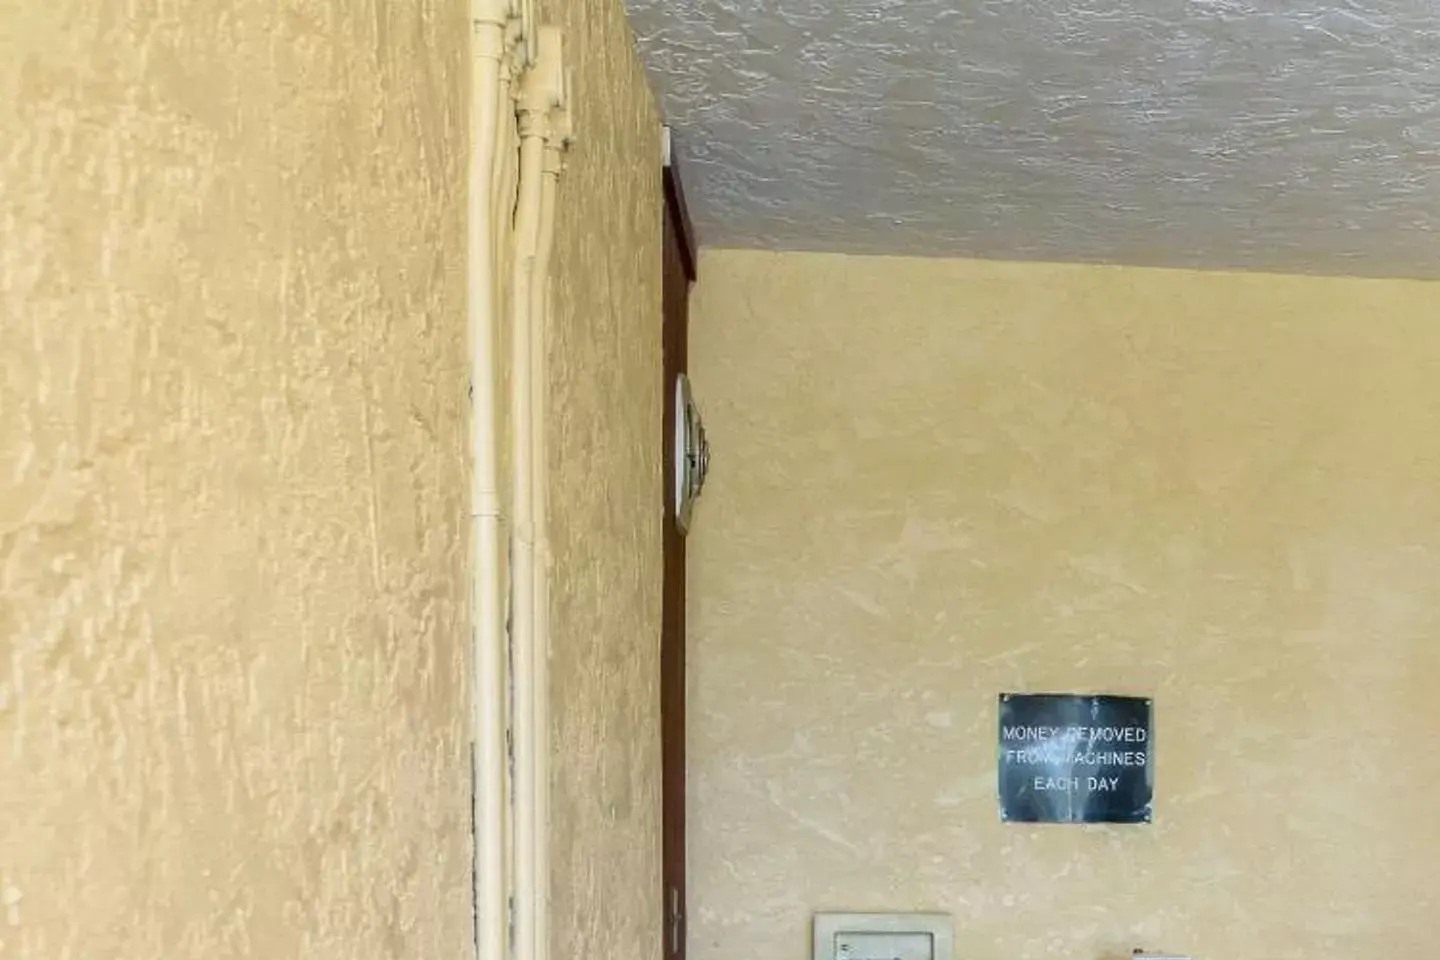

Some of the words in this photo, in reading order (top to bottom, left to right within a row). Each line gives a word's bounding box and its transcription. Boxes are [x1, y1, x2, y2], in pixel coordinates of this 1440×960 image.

[1003, 727, 1060, 741] MONEY
[1066, 727, 1146, 742] REMOVED
[1034, 777, 1079, 790] EACH
[1088, 777, 1119, 791] DAY
